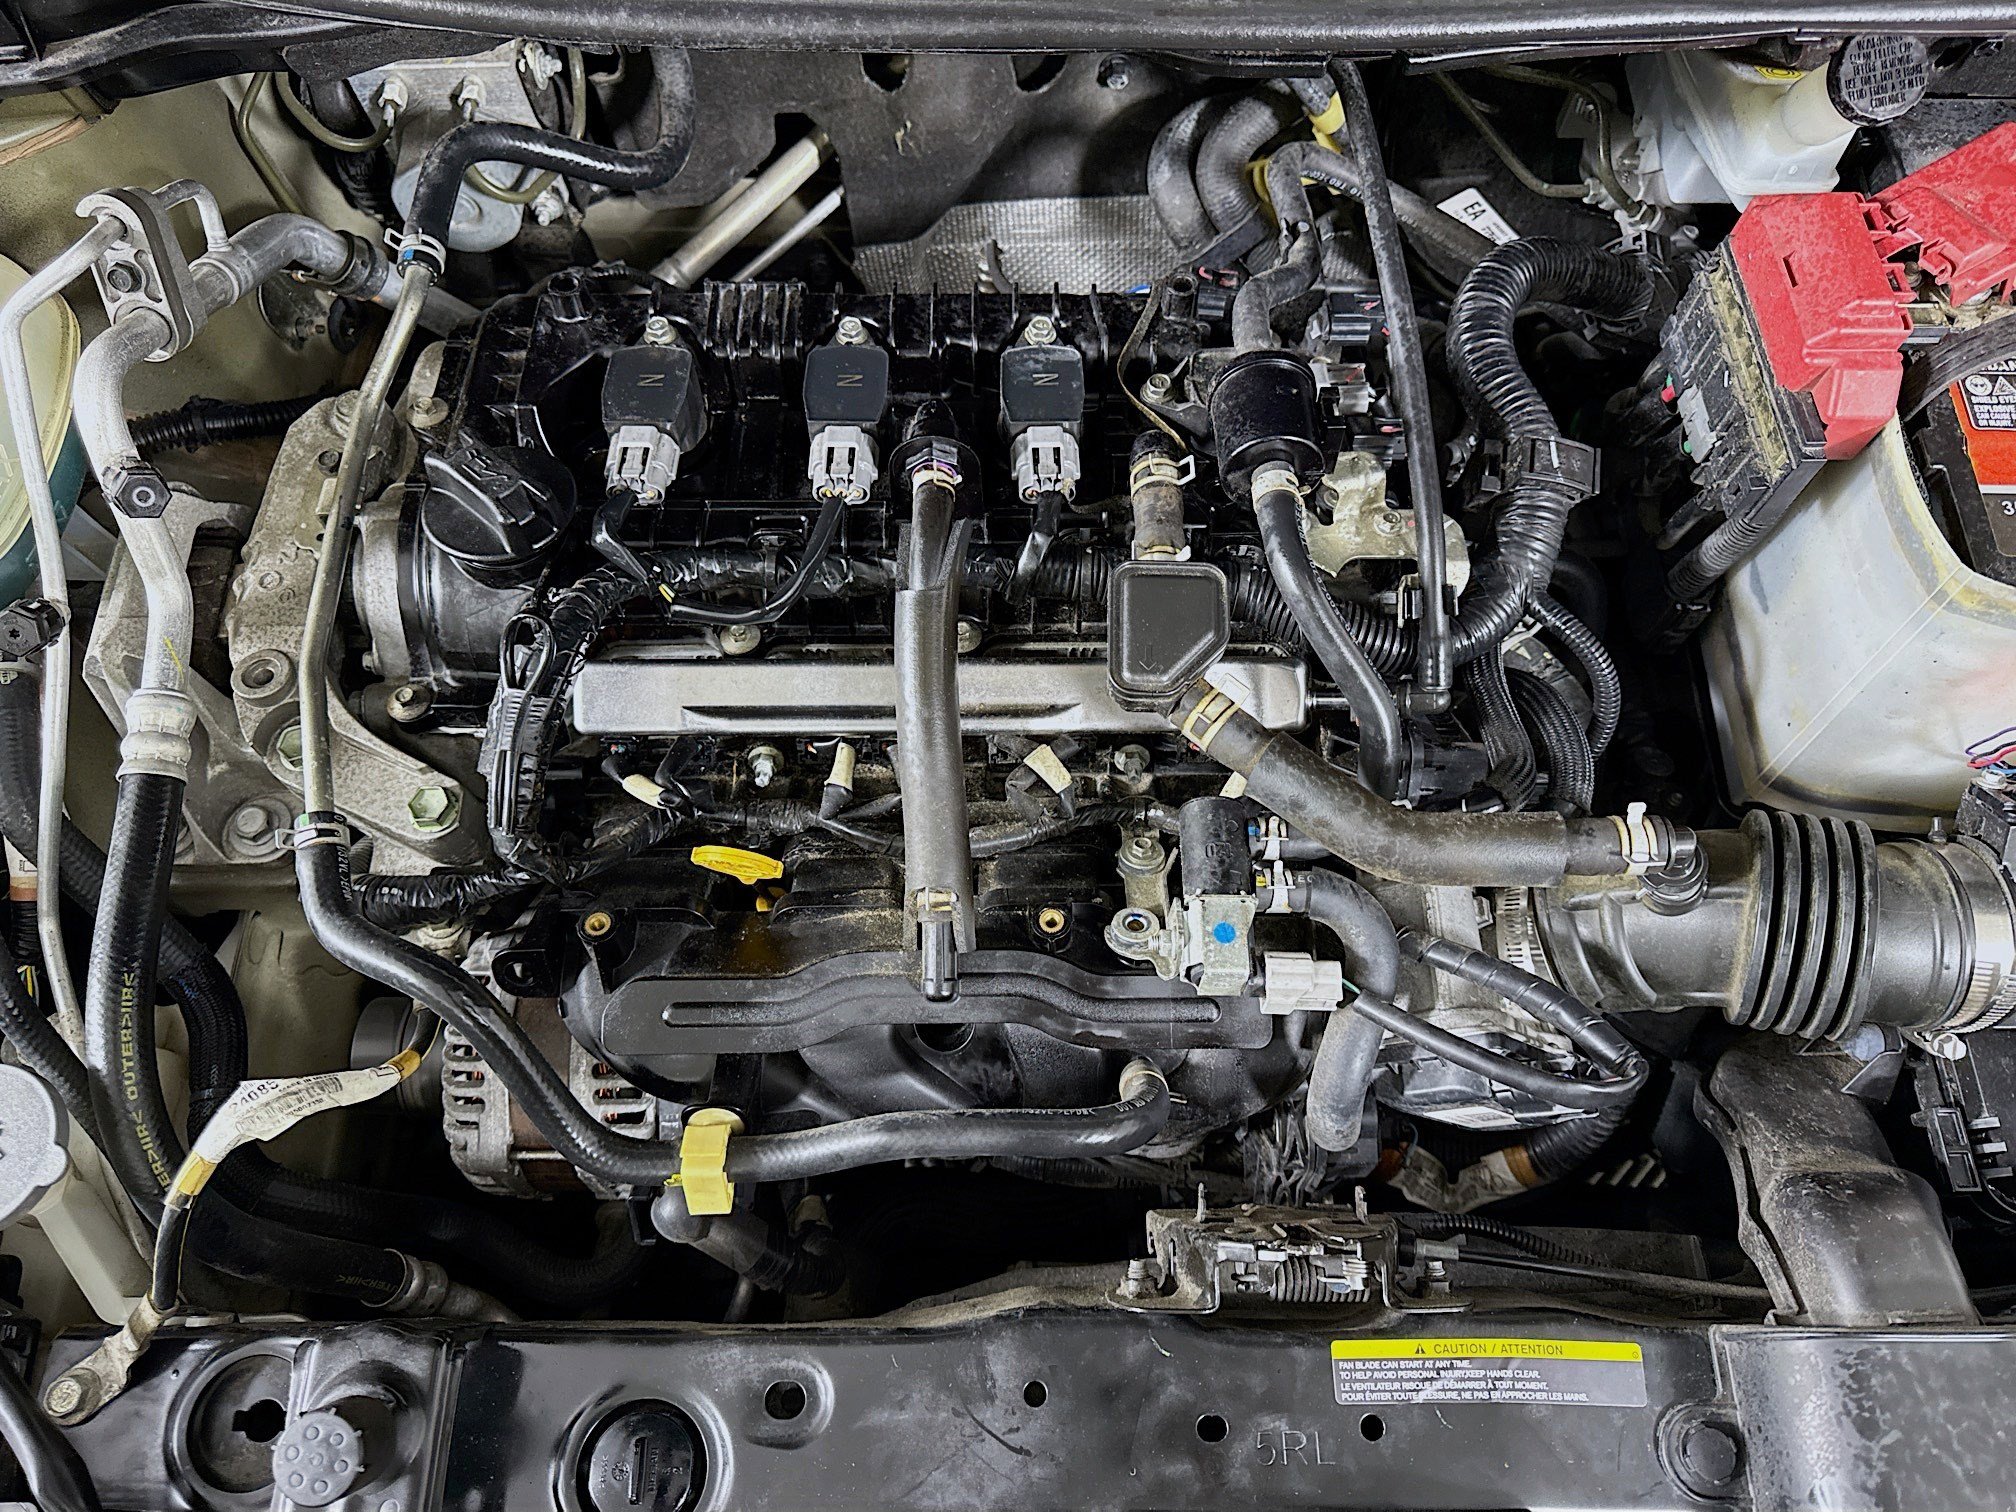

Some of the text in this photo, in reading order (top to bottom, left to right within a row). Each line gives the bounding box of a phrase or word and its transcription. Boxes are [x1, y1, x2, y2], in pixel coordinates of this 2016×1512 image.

[1899, 41, 1913, 53] CAP
[1463, 198, 1487, 222] EA
[1971, 395, 1998, 404] SHIELD
[2001, 500, 2016, 516] 3
[1434, 1343, 1563, 1355] CAUTION / ATTENTION
[1339, 1359, 1472, 1370] FAN BLADE CAN START AT ANY TIME.
[1339, 1371, 1351, 1380] TO
[1352, 1371, 1372, 1380] HELP
[1373, 1370, 1396, 1379] AVOID
[1398, 1370, 1439, 1379] PERSONAL
[1486, 1370, 1513, 1379] HANDS
[1514, 1370, 1541, 1379] CLEAR.
[1341, 1382, 1351, 1391] LE
[1351, 1381, 1401, 1391] VENTILATEUR
[1402, 1381, 1432, 1390] RISQUE
[1444, 1379, 1486, 1389] DÉMARRER
[1487, 1378, 1494, 1389] À
[1495, 1380, 1514, 1389] TOUT
[1514, 1381, 1549, 1390] MOMENT.
[1342, 1392, 1364, 1401] POUR
[1365, 1391, 1392, 1401] ÉVITER
[1393, 1391, 1418, 1401] TOUTE
[1461, 1391, 1473, 1400] NE
[1473, 1390, 1489, 1399] PAS
[1490, 1391, 1501, 1399] EN
[1501, 1391, 1549, 1400] APPROCHER
[1549, 1392, 1561, 1400] LES
[1561, 1392, 1589, 1401] MAINS.
[1256, 1430, 1337, 1466] 5RL
